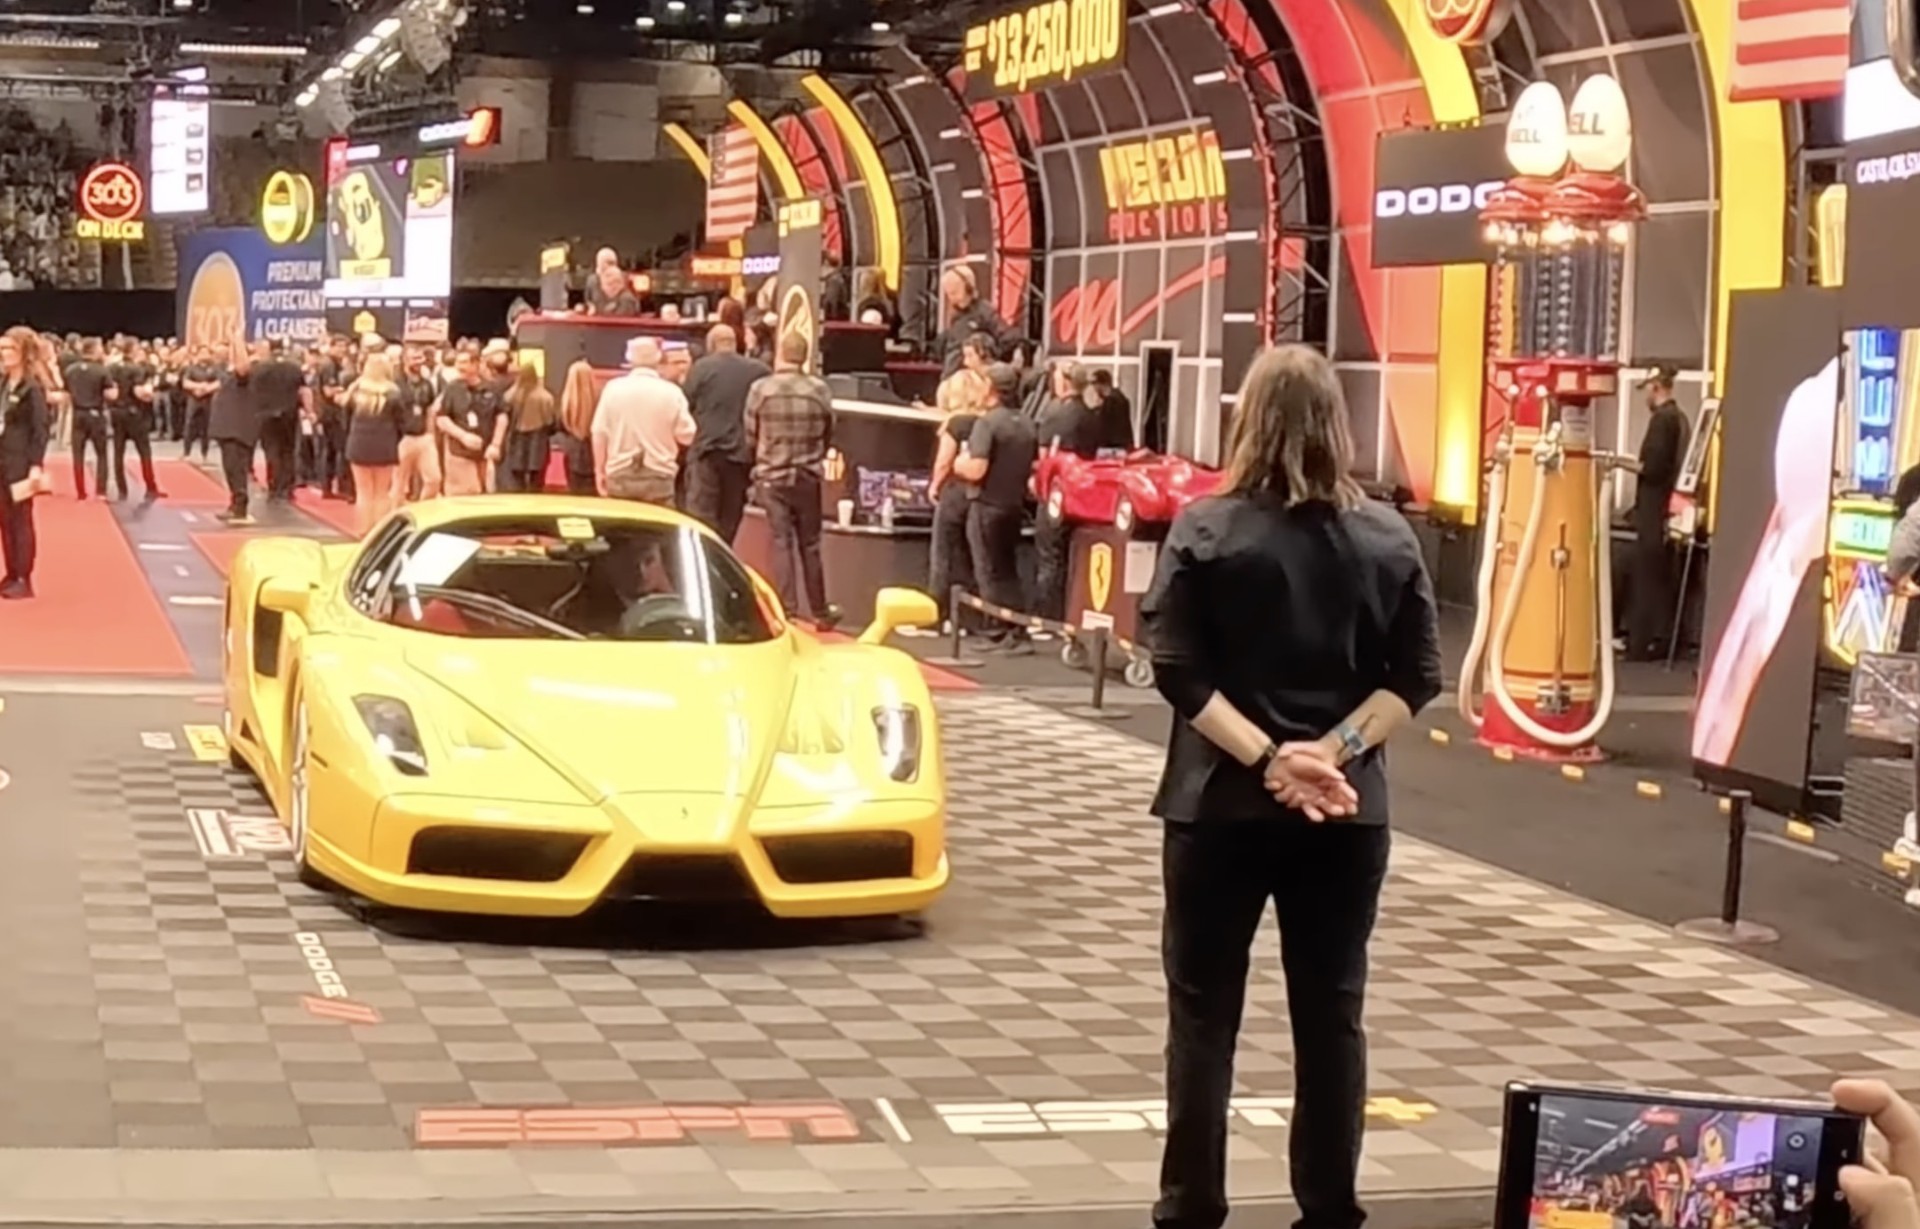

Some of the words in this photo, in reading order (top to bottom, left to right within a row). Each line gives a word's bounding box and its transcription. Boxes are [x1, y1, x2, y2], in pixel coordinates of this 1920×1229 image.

[988, 0, 1121, 92] $13,250,000
[89, 173, 134, 206] 303
[77, 219, 99, 237] ON
[267, 260, 323, 283] PREMIUM
[295, 932, 348, 998] DODGE
[418, 1106, 860, 1143] ESPN
